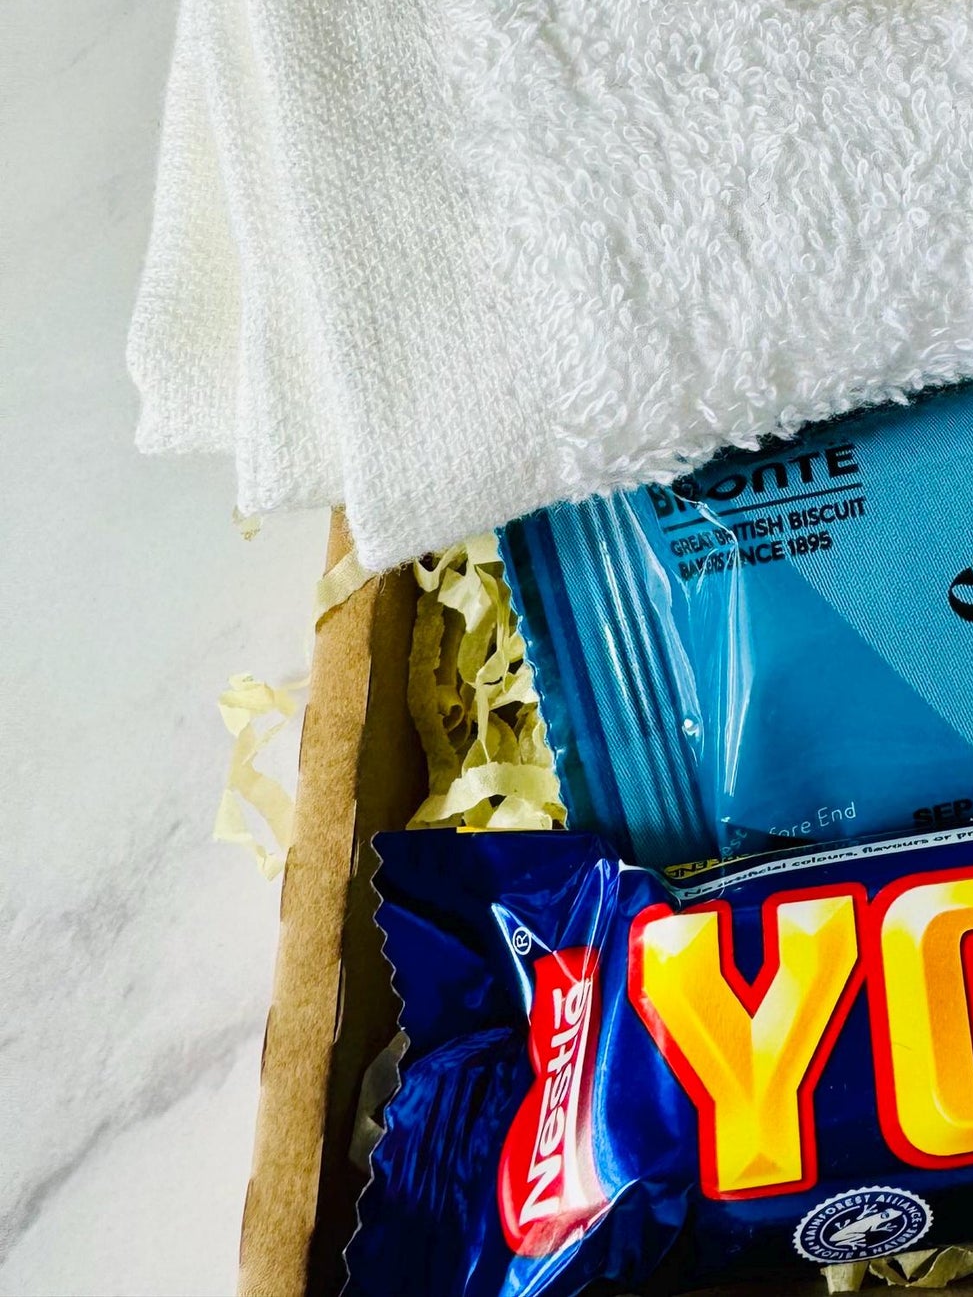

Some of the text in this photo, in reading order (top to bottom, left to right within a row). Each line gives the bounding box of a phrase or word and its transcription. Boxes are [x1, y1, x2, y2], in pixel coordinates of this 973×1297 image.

[670, 530, 714, 558] GREAT
[788, 496, 867, 531] BISCUIT
[786, 531, 833, 557] 1895
[817, 801, 857, 828] End
[912, 797, 973, 825] SEP
